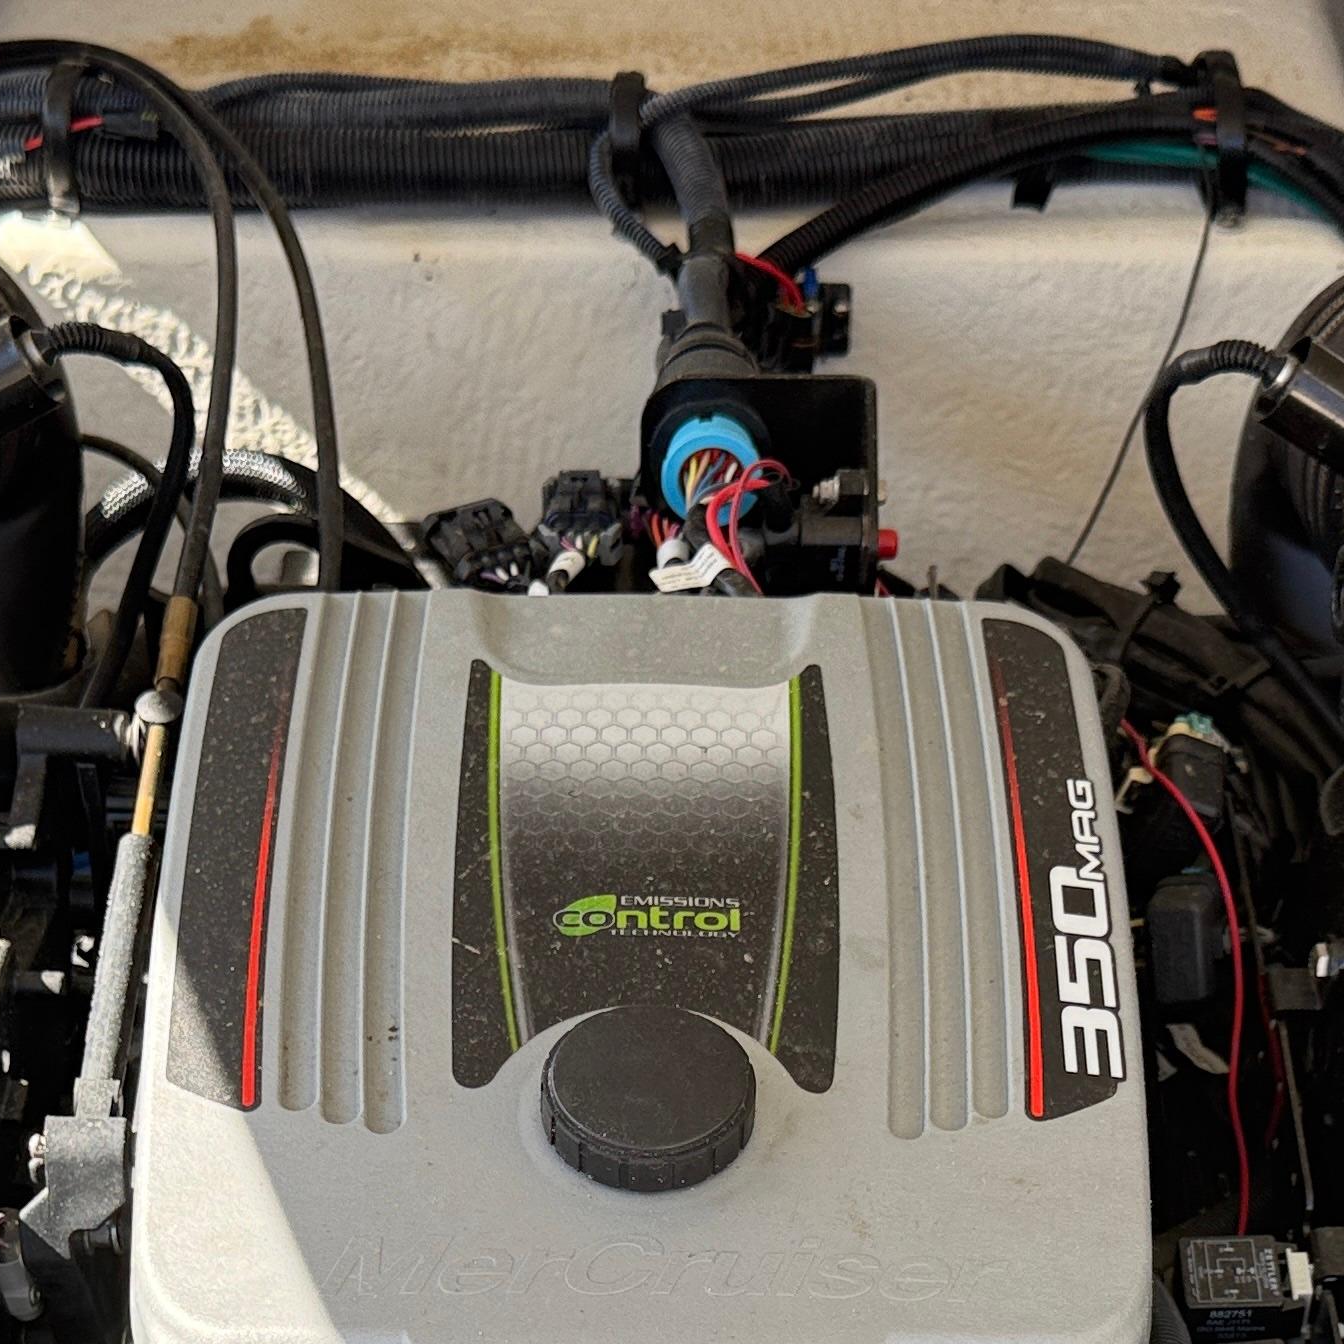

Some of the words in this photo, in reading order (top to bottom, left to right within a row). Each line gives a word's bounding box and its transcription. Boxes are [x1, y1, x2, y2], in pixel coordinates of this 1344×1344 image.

[1066, 777, 1109, 884] MAG
[553, 906, 741, 931] control
[620, 895, 741, 909] EMISSIONS
[610, 929, 739, 938] TECHNOLOGY
[1049, 863, 1126, 1082] 350
[323, 1235, 1009, 1302] MerCruiser
